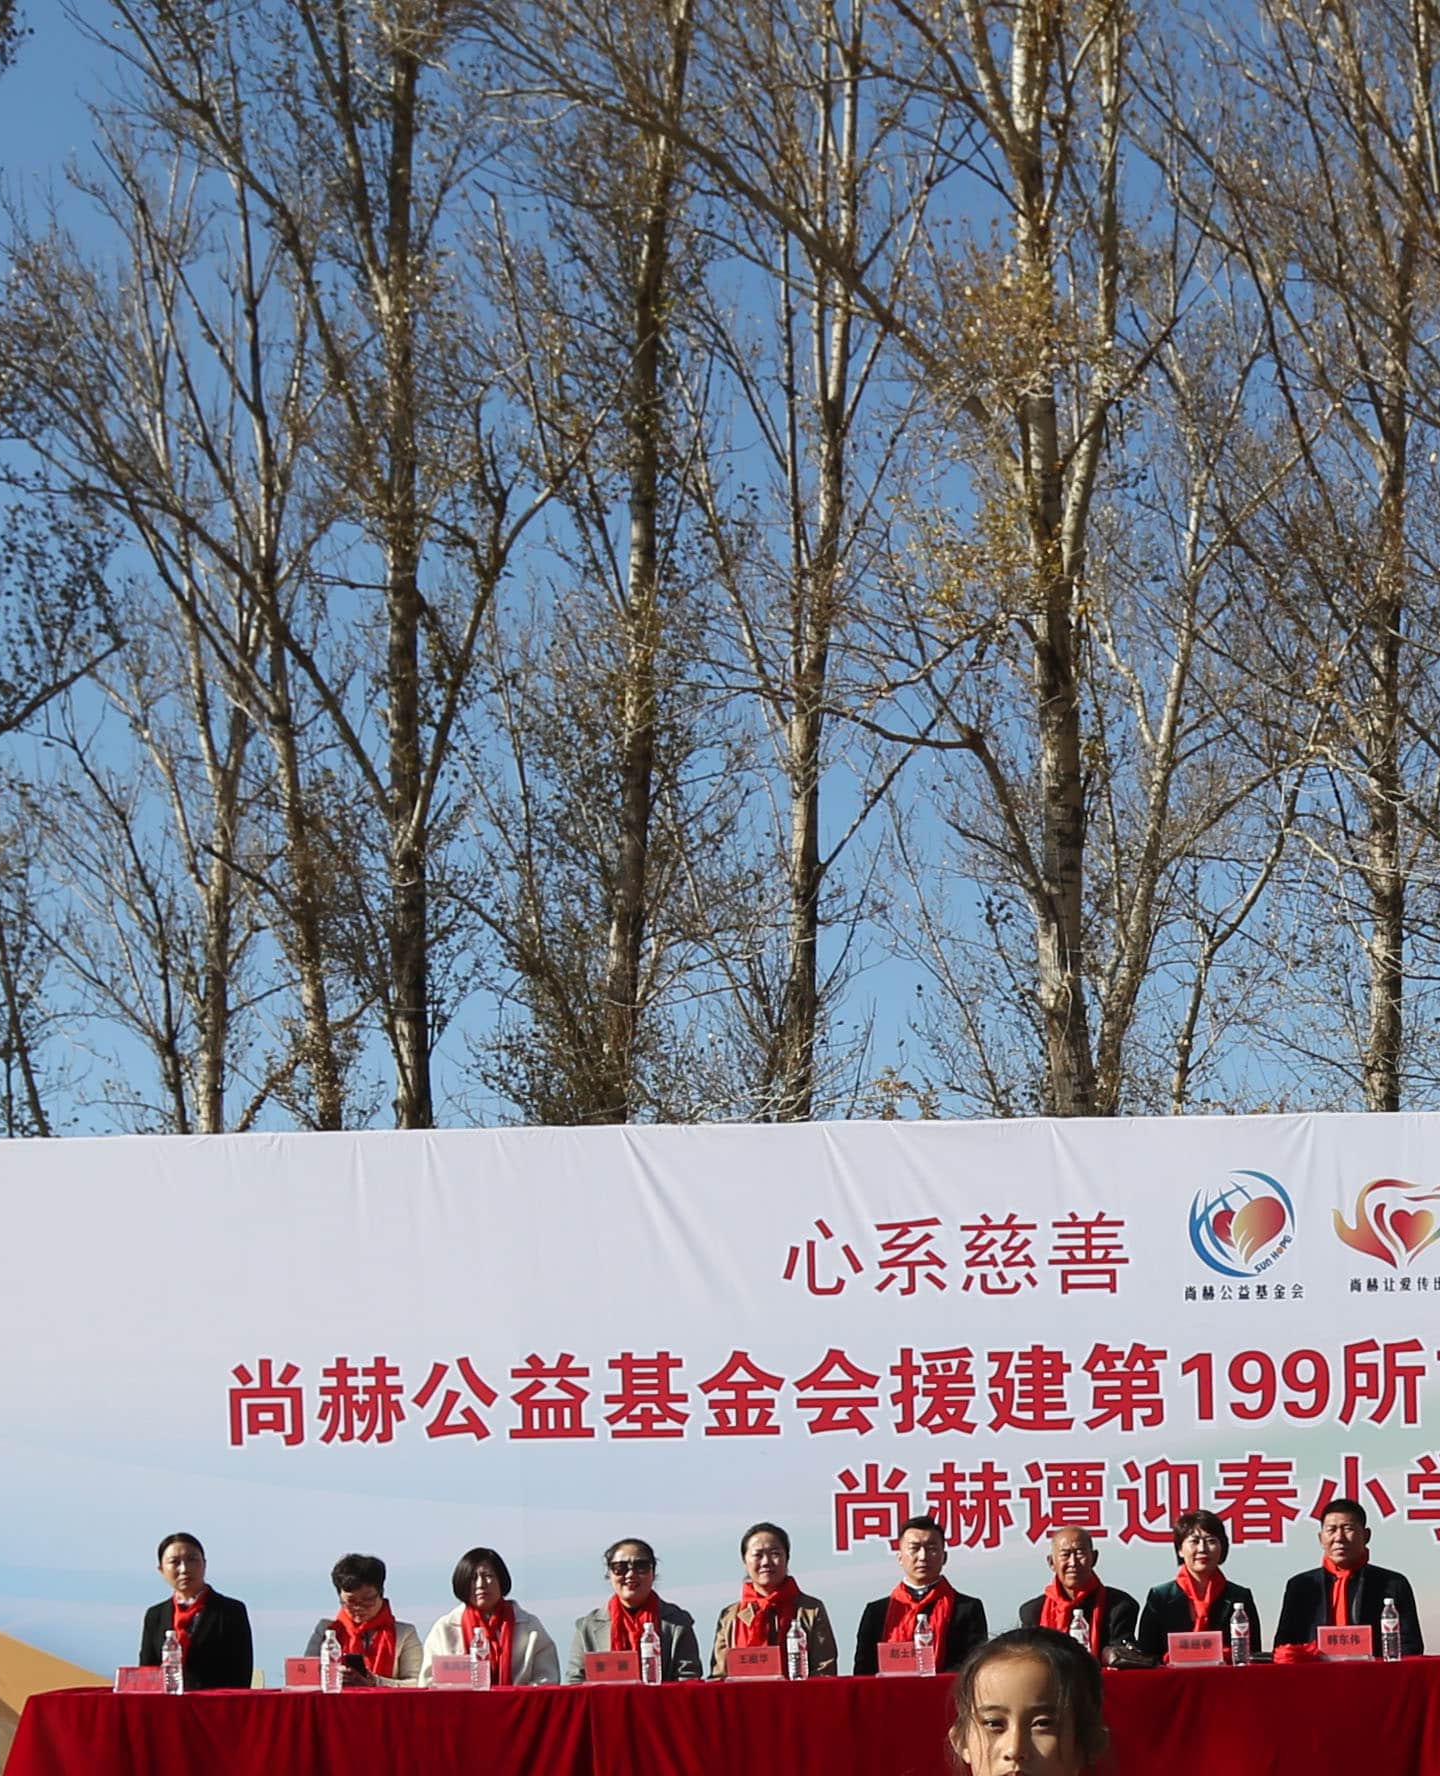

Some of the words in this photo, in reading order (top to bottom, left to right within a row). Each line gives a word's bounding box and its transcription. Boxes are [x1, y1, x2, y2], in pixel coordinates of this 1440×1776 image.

[782, 1211, 1130, 1296] 心系慈善
[1185, 1283, 1304, 1301] 尚赫公益基金会
